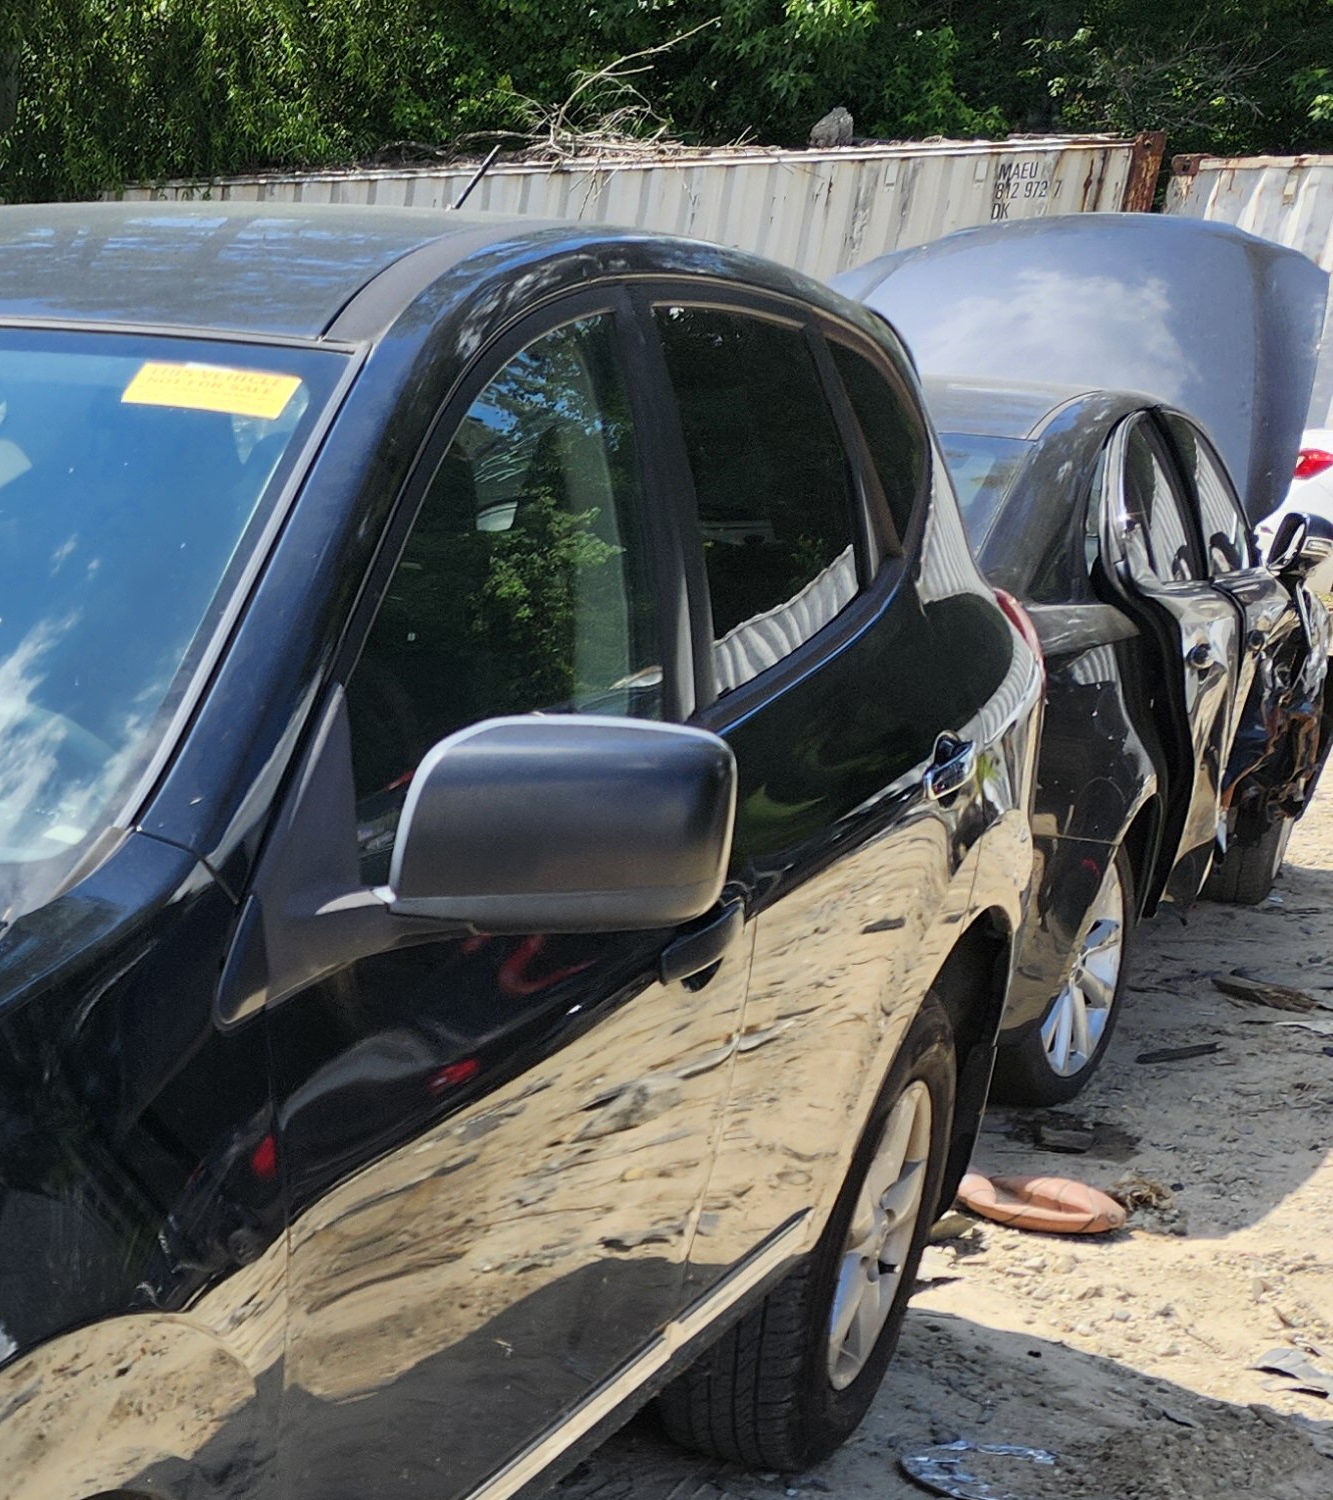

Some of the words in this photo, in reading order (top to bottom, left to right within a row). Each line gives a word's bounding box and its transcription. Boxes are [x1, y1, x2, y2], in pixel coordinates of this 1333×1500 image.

[998, 162, 1039, 180] MAEU
[994, 182, 1020, 199] 812
[1024, 181, 1048, 198] 972
[1053, 180, 1062, 198] 7
[991, 203, 1010, 220] DK
